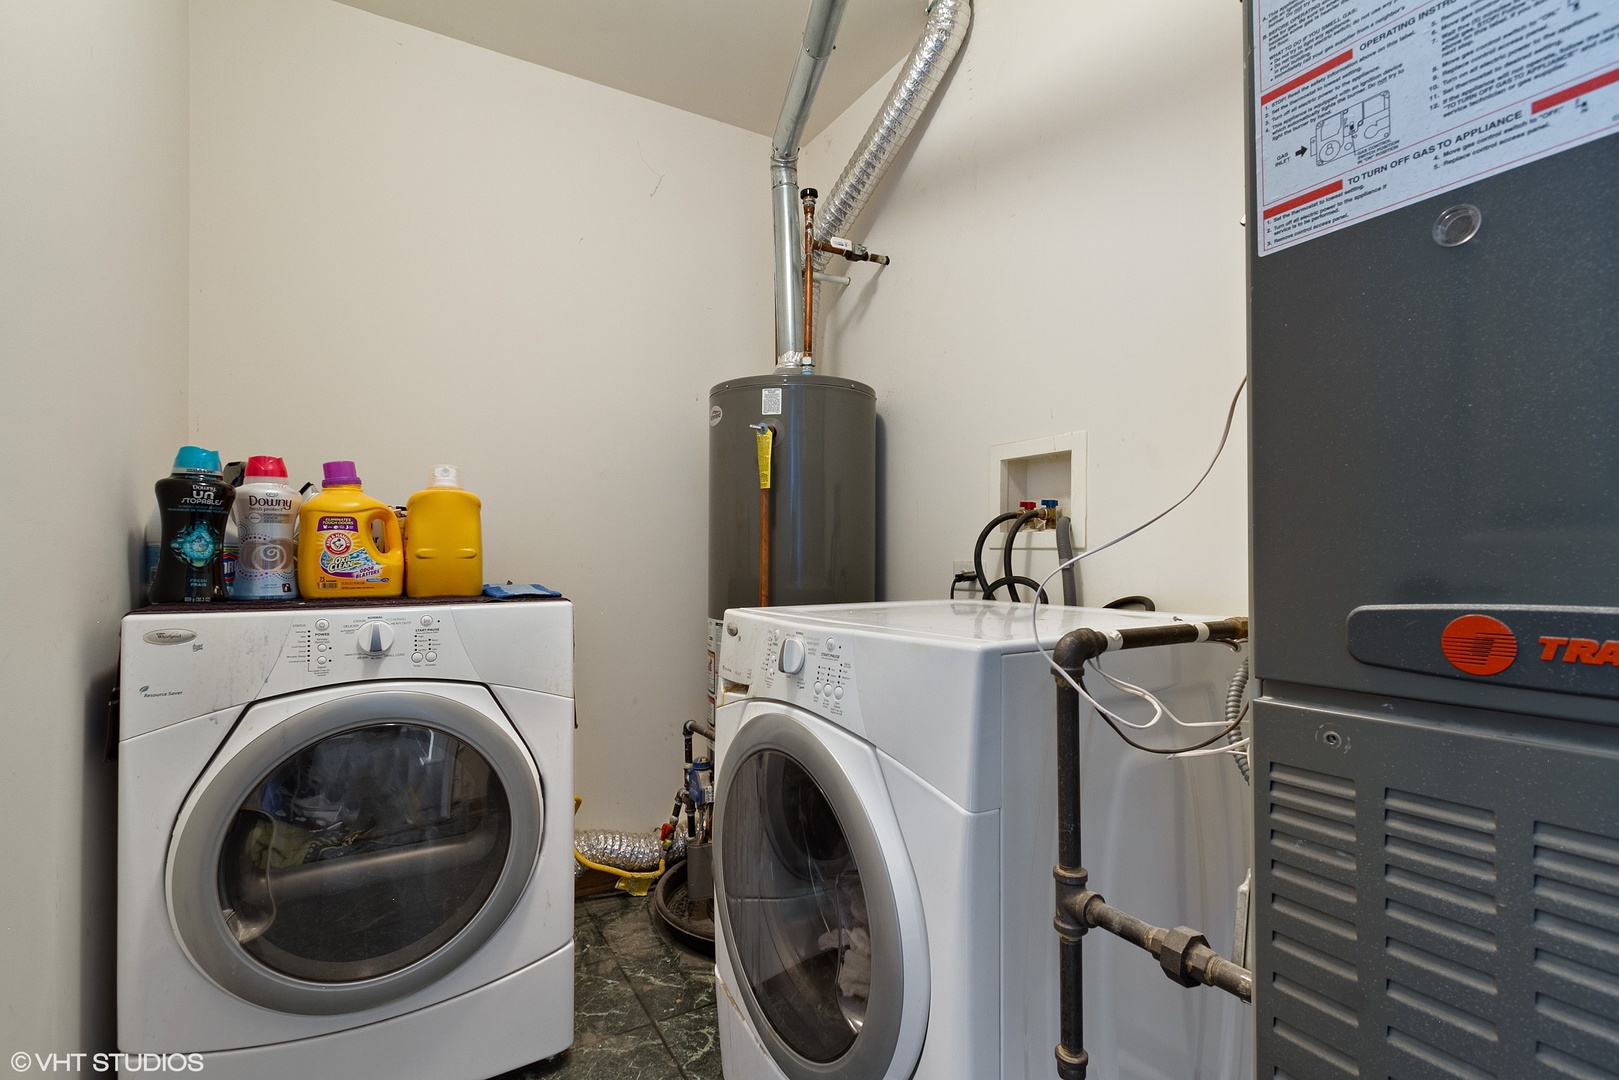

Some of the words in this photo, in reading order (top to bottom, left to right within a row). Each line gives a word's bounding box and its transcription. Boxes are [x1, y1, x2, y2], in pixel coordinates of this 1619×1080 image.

[1359, 17, 1415, 50] OPERATING
[1347, 175, 1360, 185] TO
[1361, 164, 1387, 179] TURN
[1390, 155, 1410, 168] OFF
[1412, 145, 1435, 159] GAS
[1437, 139, 1452, 149] TO
[1455, 111, 1521, 143] APPLIANCE
[181, 498, 224, 506] STOPABLES
[249, 495, 292, 510] Downy
[330, 562, 353, 571] CLEAN
[356, 569, 379, 578] BLASTERS
